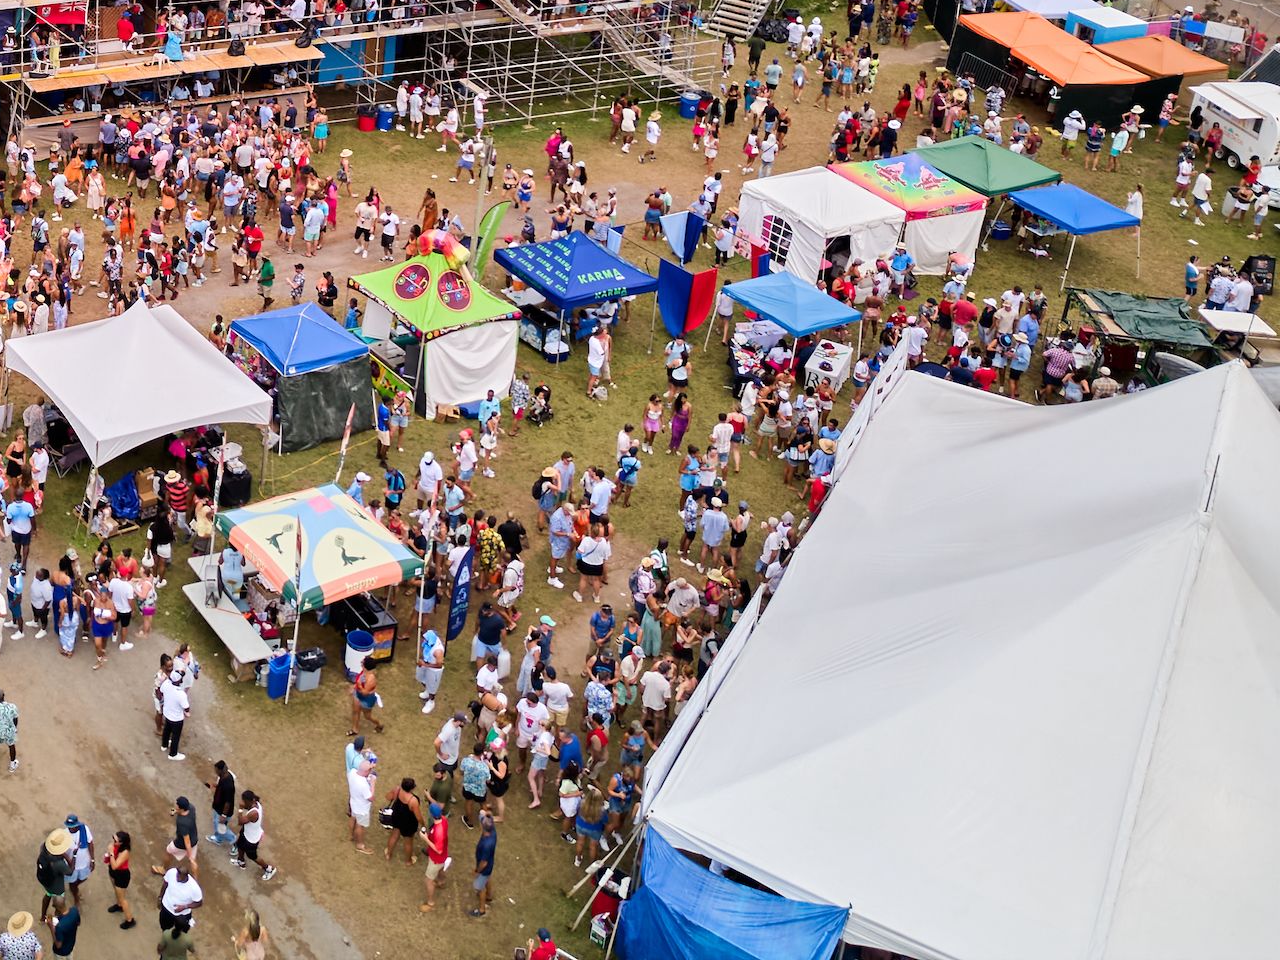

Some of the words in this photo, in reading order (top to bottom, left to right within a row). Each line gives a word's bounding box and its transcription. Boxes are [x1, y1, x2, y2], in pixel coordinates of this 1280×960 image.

[577, 268, 622, 285] KARMA
[595, 287, 628, 299] KARMA
[344, 576, 378, 591] happy
